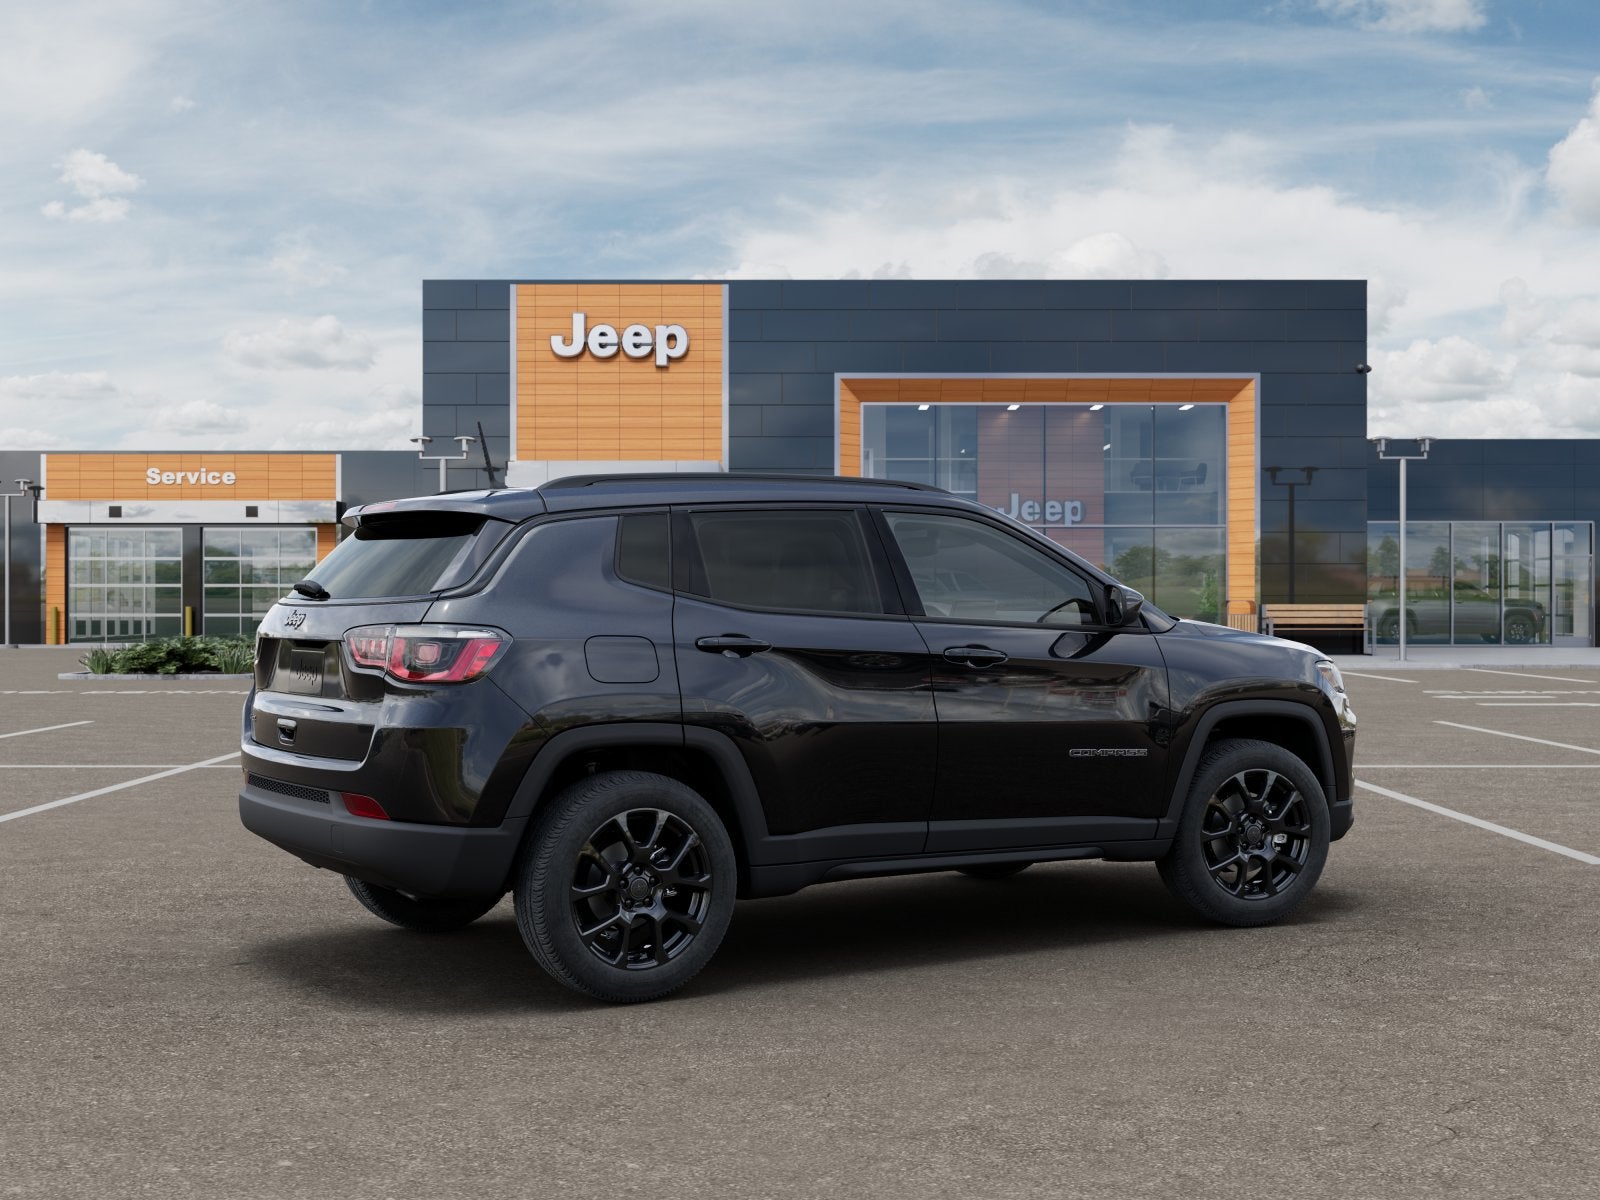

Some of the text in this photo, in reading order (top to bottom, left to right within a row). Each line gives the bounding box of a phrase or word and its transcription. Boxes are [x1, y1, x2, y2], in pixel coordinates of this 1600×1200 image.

[550, 312, 689, 367] Jeep
[146, 467, 237, 486] Service
[284, 610, 307, 630] Jeep
[1068, 748, 1148, 757] COMPASS
